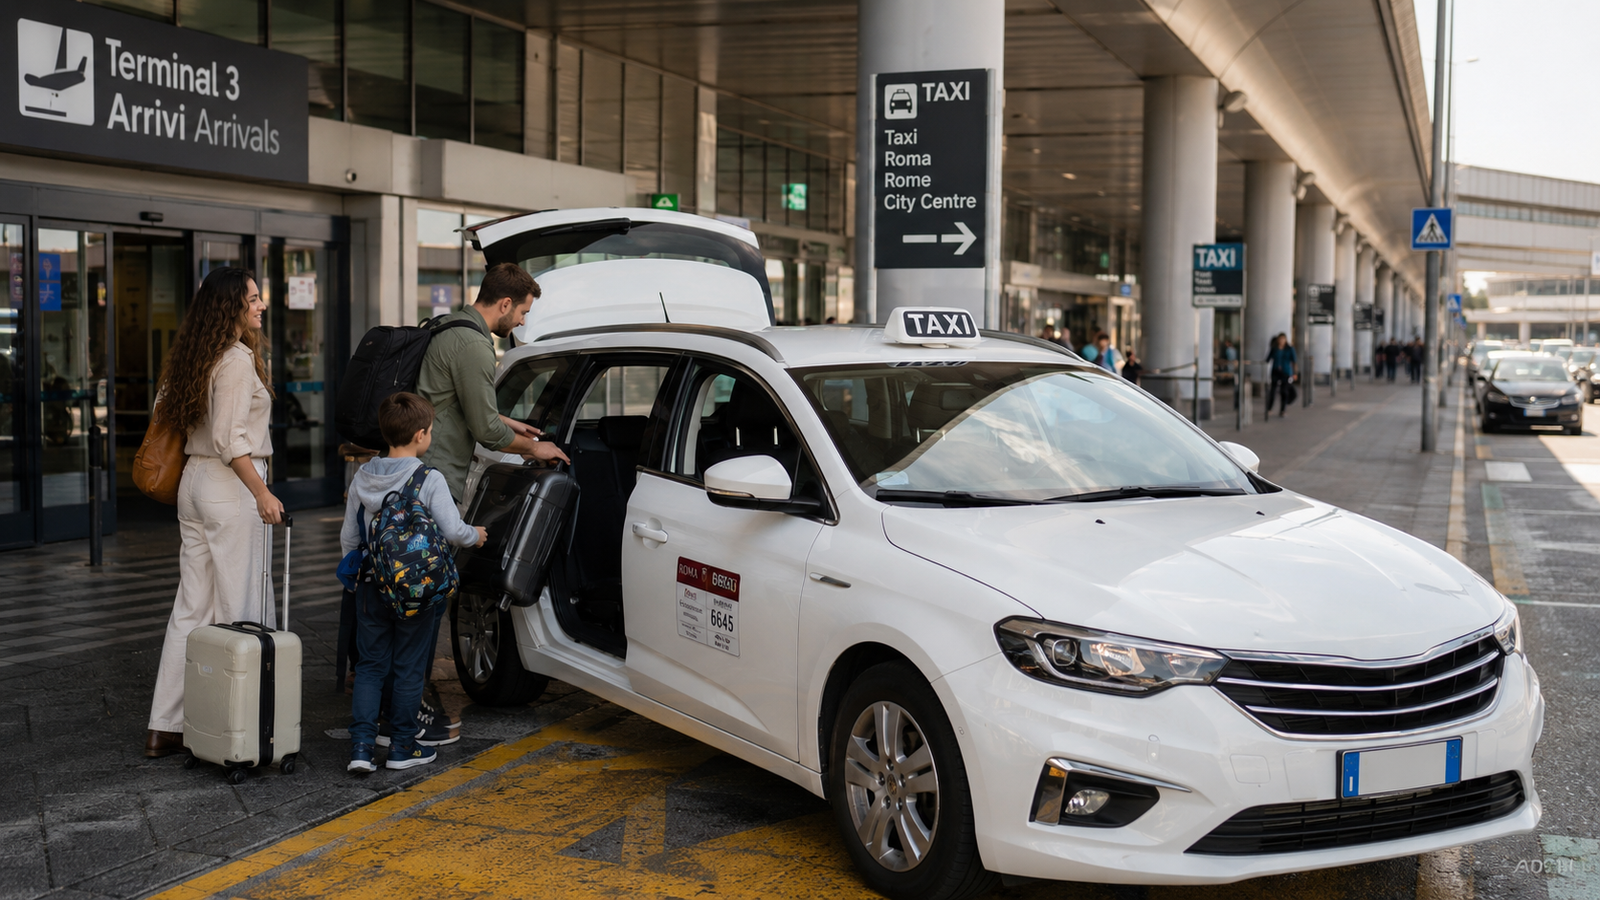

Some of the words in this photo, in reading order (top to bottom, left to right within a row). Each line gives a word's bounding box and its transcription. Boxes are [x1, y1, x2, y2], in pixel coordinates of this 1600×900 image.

[105, 37, 219, 97] Terminal
[225, 65, 240, 101] 3
[922, 81, 970, 102] TAXI
[107, 93, 186, 140] Arrivi
[194, 108, 280, 155] Arrivals
[884, 128, 918, 145] Taxi
[885, 151, 932, 167] Roma
[885, 172, 932, 188] Rome
[884, 194, 916, 213] City
[920, 193, 977, 209] Centre
[1195, 248, 1236, 268] TAXI
[907, 313, 971, 335] TAXI
[711, 609, 734, 632] 6645
